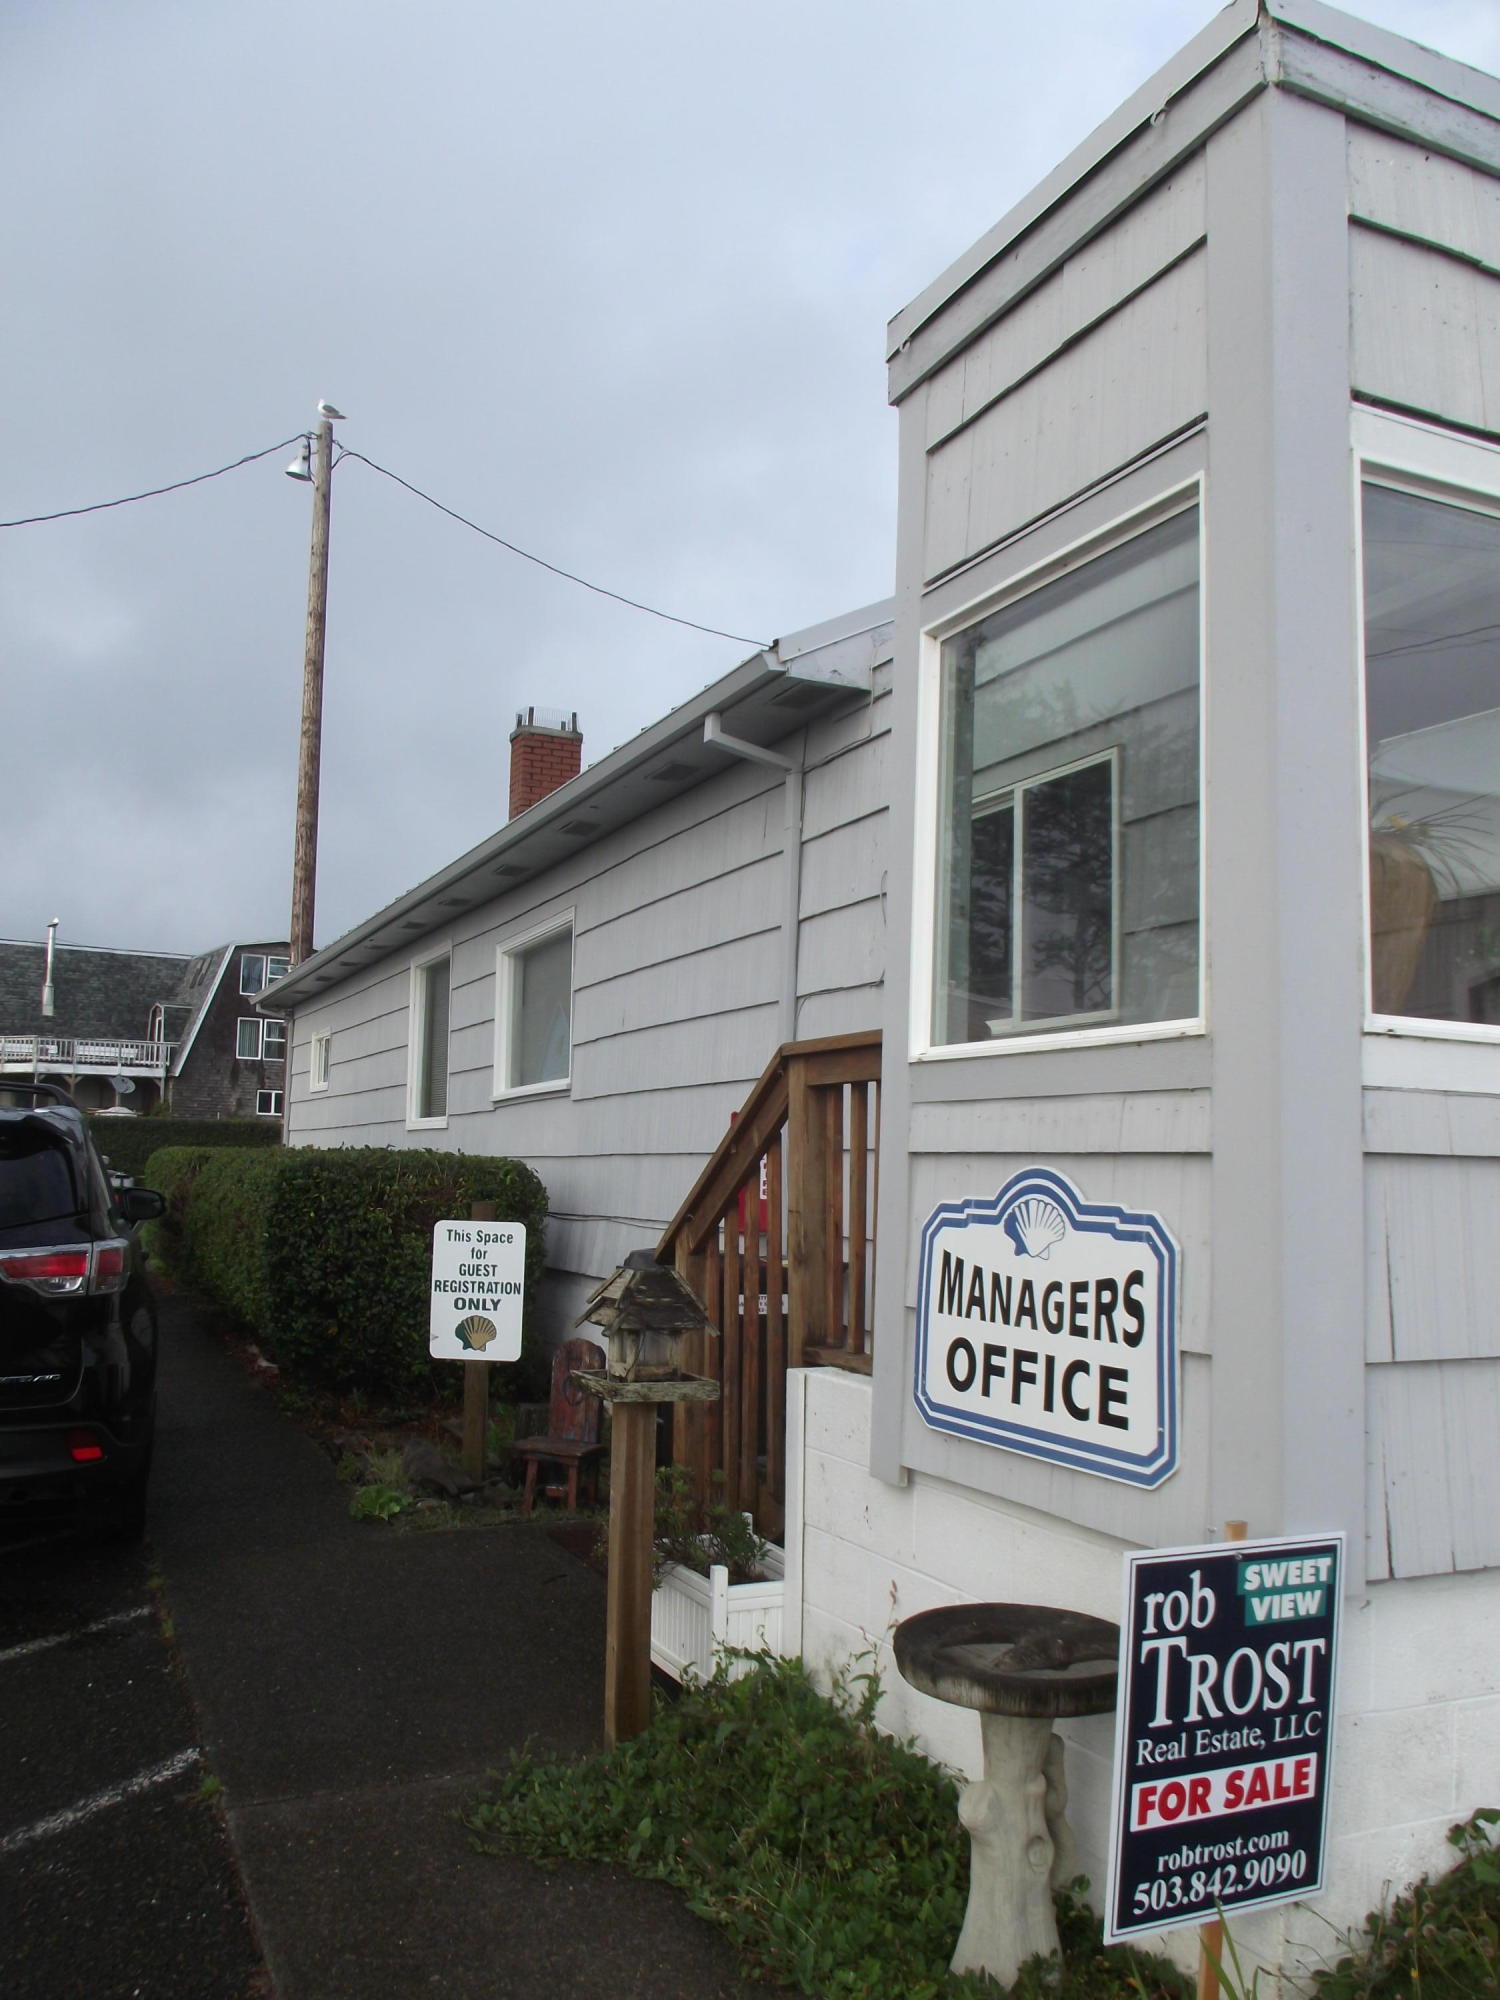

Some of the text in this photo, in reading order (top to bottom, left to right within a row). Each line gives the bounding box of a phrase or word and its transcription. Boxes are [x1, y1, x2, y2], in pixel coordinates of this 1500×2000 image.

[447, 1229, 513, 1246] This Space
[471, 1247, 488, 1260] for
[434, 1280, 521, 1295] REGISTRATION
[459, 1263, 498, 1277] GUEST
[453, 1297, 501, 1311] ONLY
[938, 1248, 1145, 1348] MANAGERS
[946, 1336, 1129, 1431] OFFICE
[1243, 1557, 1332, 1591] SWEET
[1142, 1569, 1216, 1634] rob
[1250, 1589, 1322, 1622] VIEW
[1140, 1636, 1326, 1728] TROST
[1135, 1711, 1322, 1766] Real Estate, LLC
[1137, 1758, 1311, 1826] FOR SALE
[1157, 1830, 1289, 1873] robtrost.com
[1133, 1849, 1307, 1915] 503.842.9090
